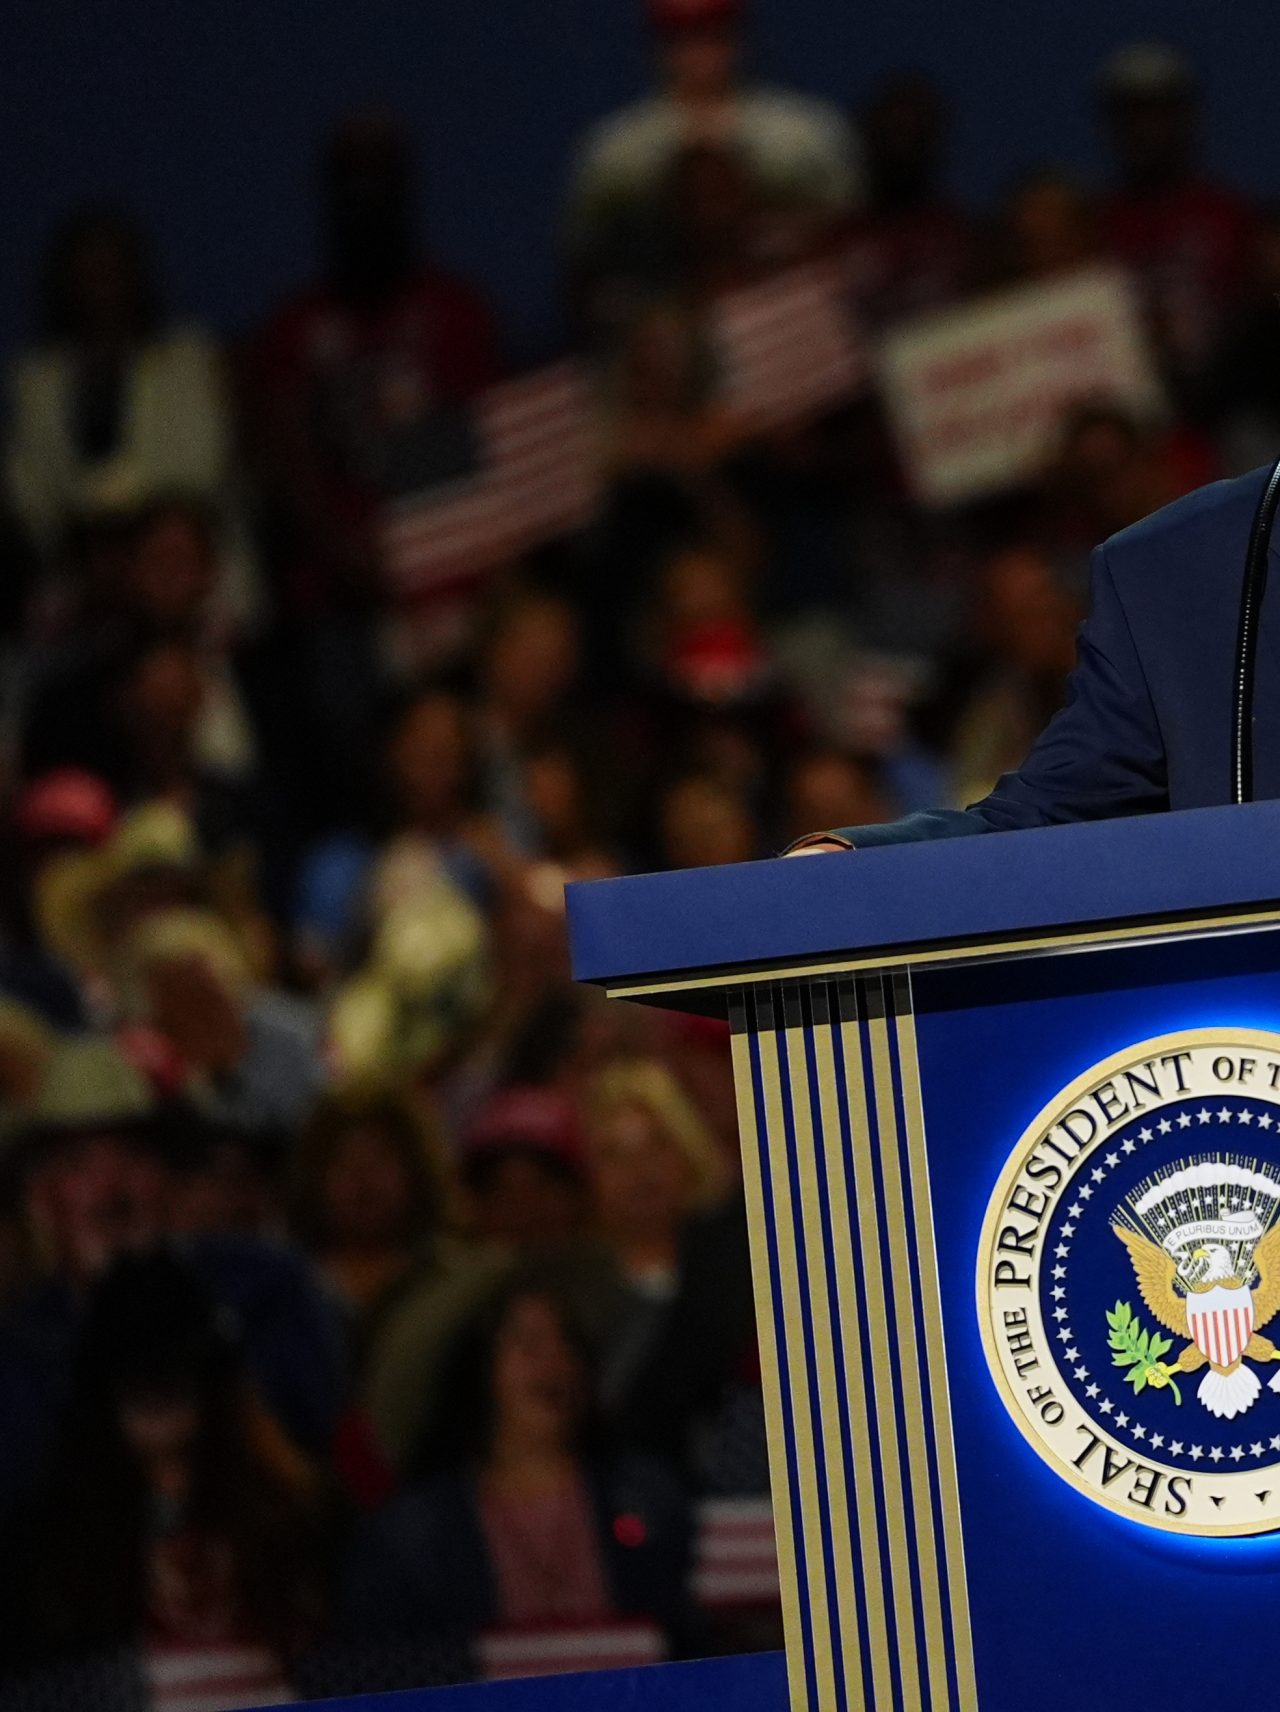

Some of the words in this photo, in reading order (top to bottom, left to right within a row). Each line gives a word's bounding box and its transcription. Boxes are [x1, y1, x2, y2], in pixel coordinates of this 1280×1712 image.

[1212, 1056, 1256, 1083] OF
[994, 1052, 1193, 1291] PRESIDENT
[1168, 1236, 1175, 1246] E
[1176, 1225, 1226, 1239] PLURIBUS
[1229, 1223, 1258, 1236] UNUM
[1003, 1306, 1040, 1380] THE
[1027, 1384, 1065, 1426] OF
[1070, 1424, 1193, 1516] SEAL
